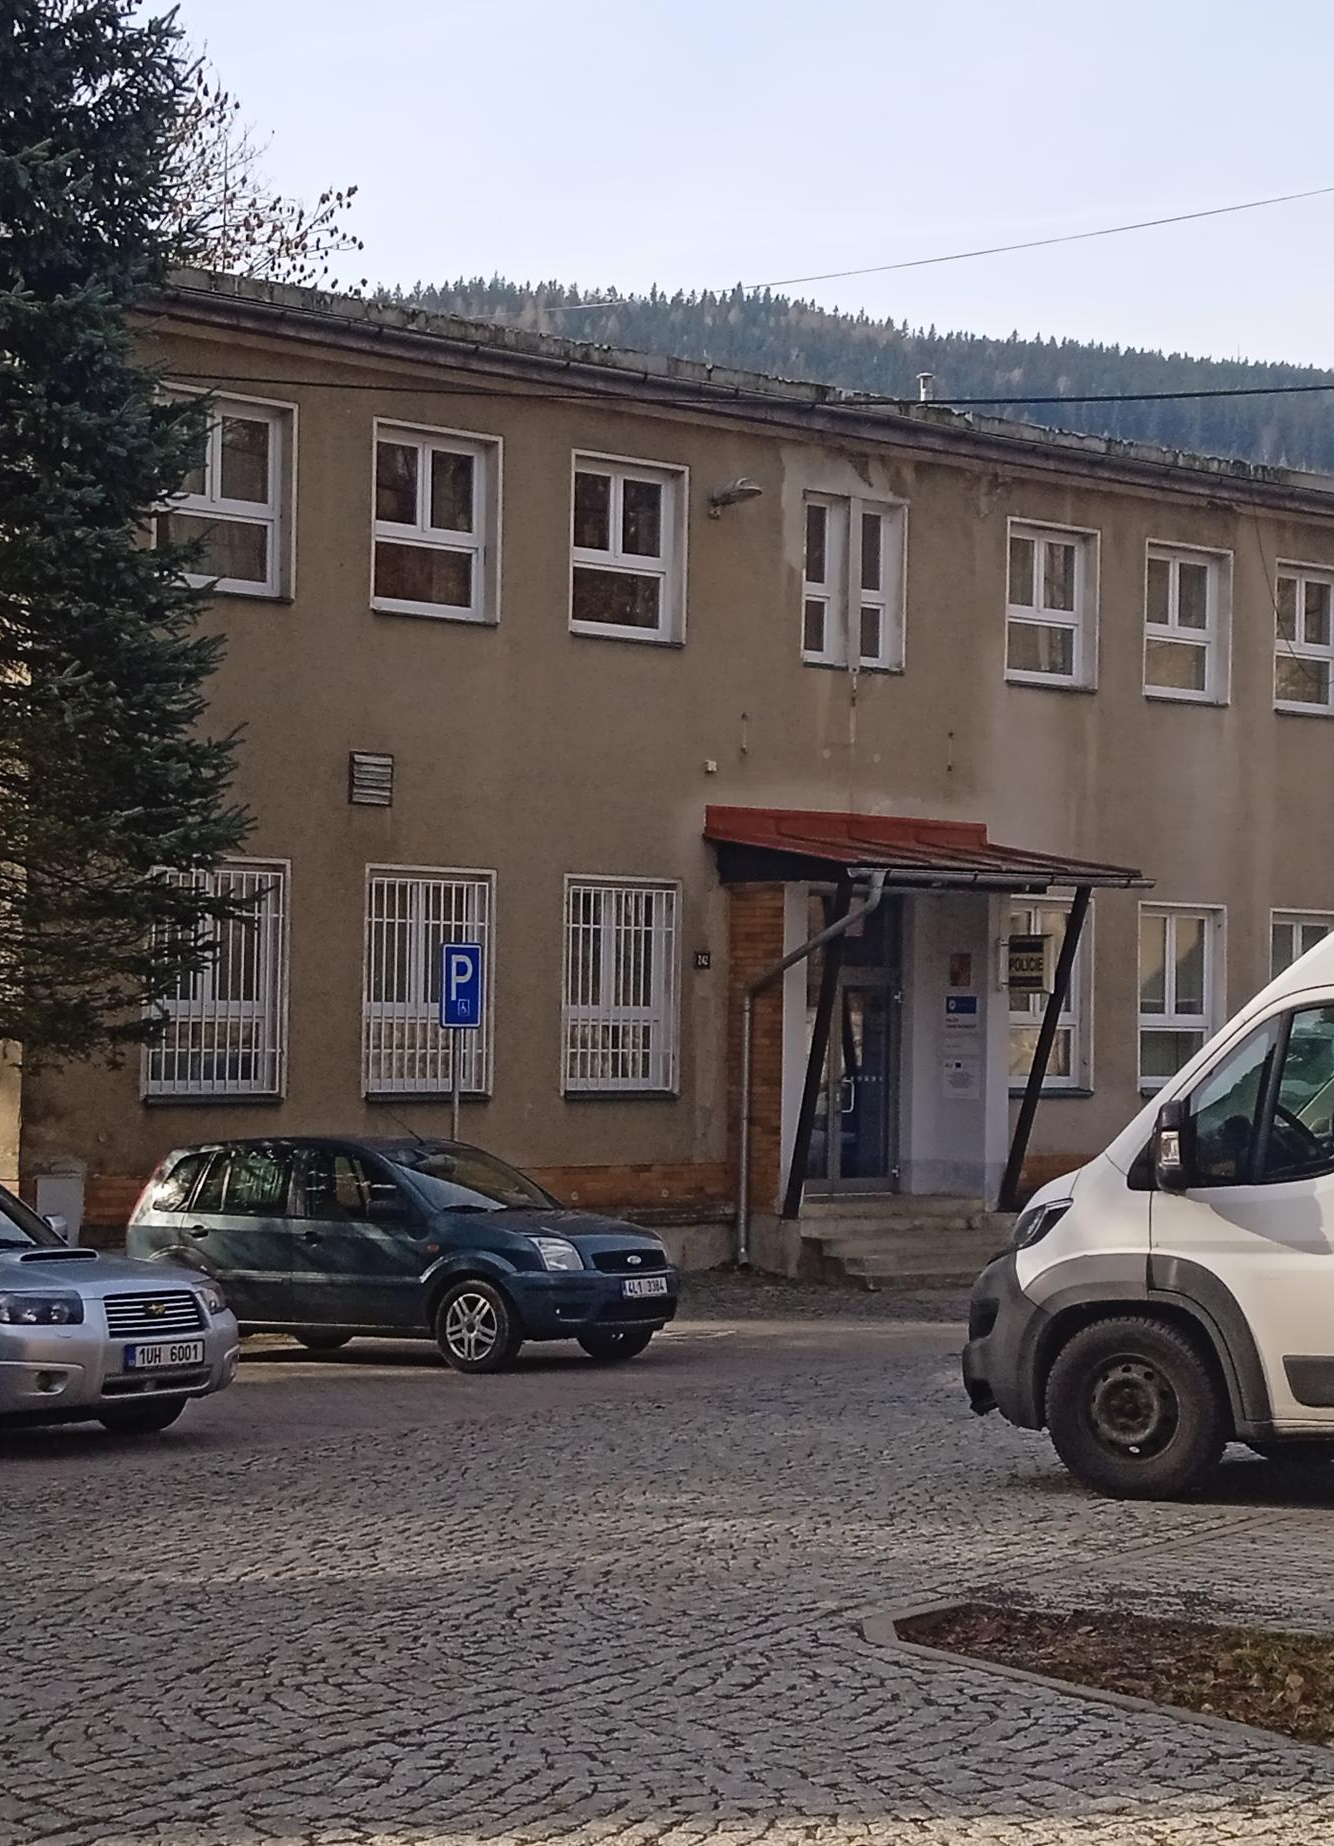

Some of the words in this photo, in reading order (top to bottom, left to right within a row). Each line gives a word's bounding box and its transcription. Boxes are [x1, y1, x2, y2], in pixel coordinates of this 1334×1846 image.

[1009, 956, 1044, 972] POLICIE
[451, 954, 473, 1001] P
[139, 1346, 162, 1364] 1UH
[170, 1343, 198, 1362] 6001
